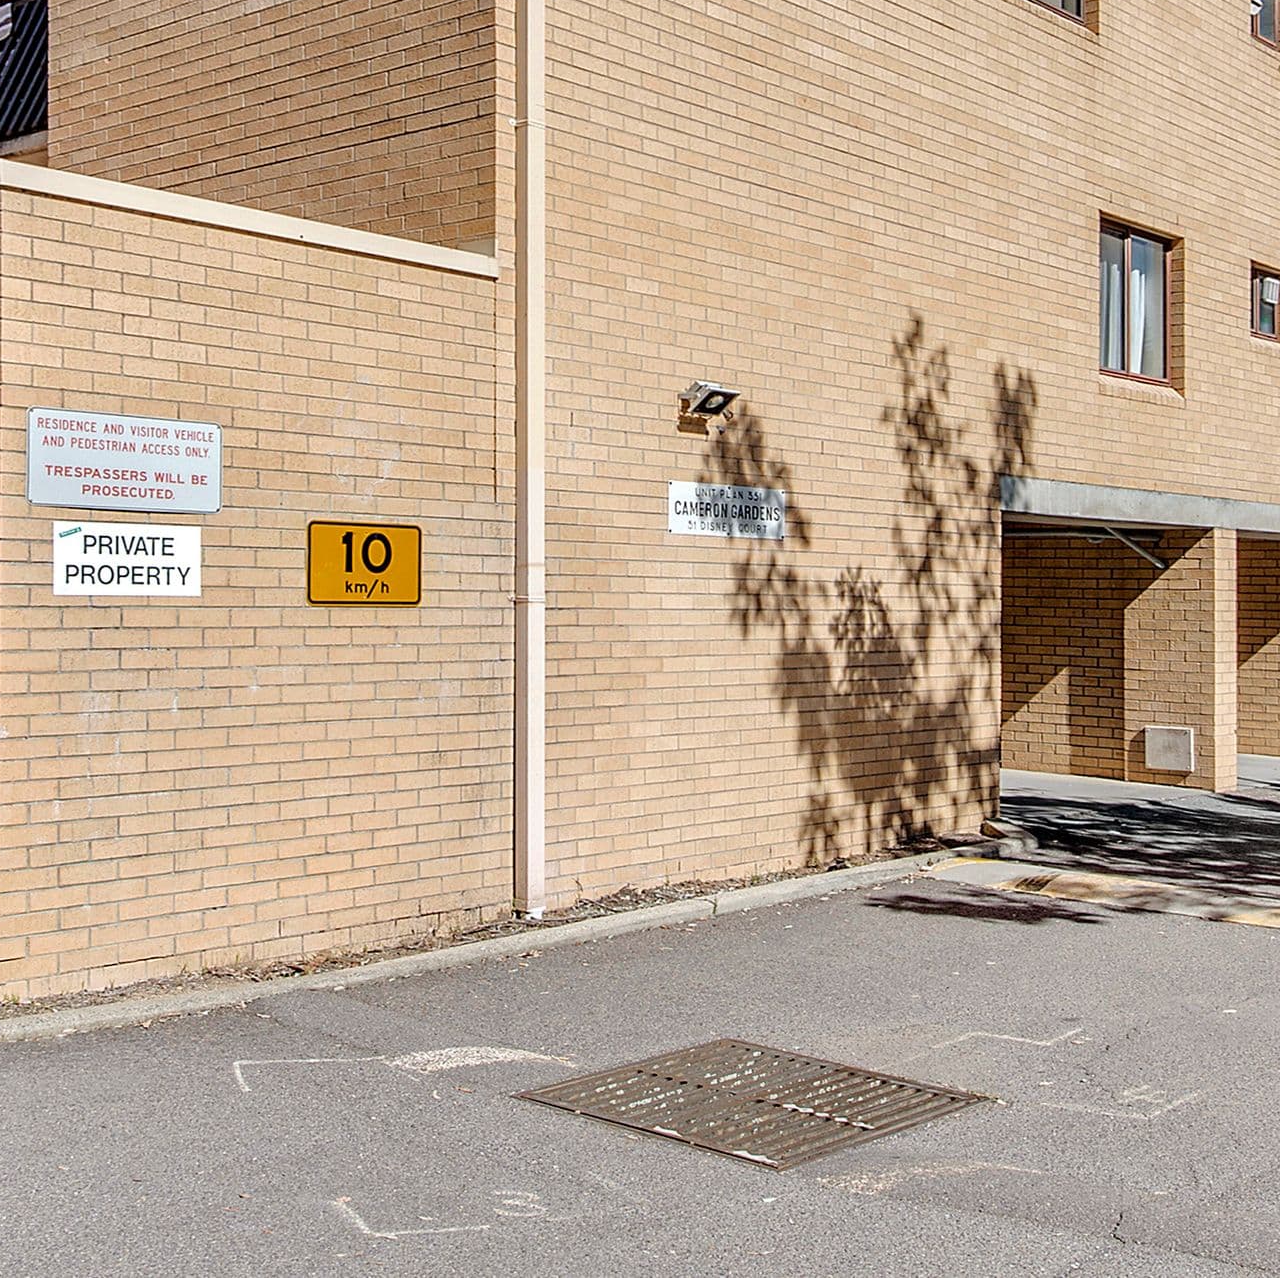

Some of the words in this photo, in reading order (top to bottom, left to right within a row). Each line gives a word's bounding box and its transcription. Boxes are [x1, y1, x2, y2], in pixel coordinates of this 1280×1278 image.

[37, 417, 97, 433] RESIDENCE
[103, 424, 125, 436] AND
[130, 425, 169, 440] VISITOR
[174, 429, 215, 443] VEHICLE
[42, 436, 65, 448] AND
[70, 438, 136, 453] PEDESTRIAN
[141, 443, 180, 456] ACCESS
[185, 446, 210, 459] ONLY.
[45, 464, 148, 482] TRESPASSERS
[154, 472, 185, 485] WILL
[191, 474, 208, 486] BE
[81, 484, 176, 500] PROSECUTED.
[674, 500, 728, 519] CAMERON
[731, 504, 781, 522] GARDENS
[700, 520, 733, 533] DISNEY
[738, 523, 767, 534] COURT
[83, 534, 175, 556] PRIVATE
[341, 531, 393, 574] 10
[65, 564, 191, 586] PROPERTY
[345, 579, 390, 599] km/h
